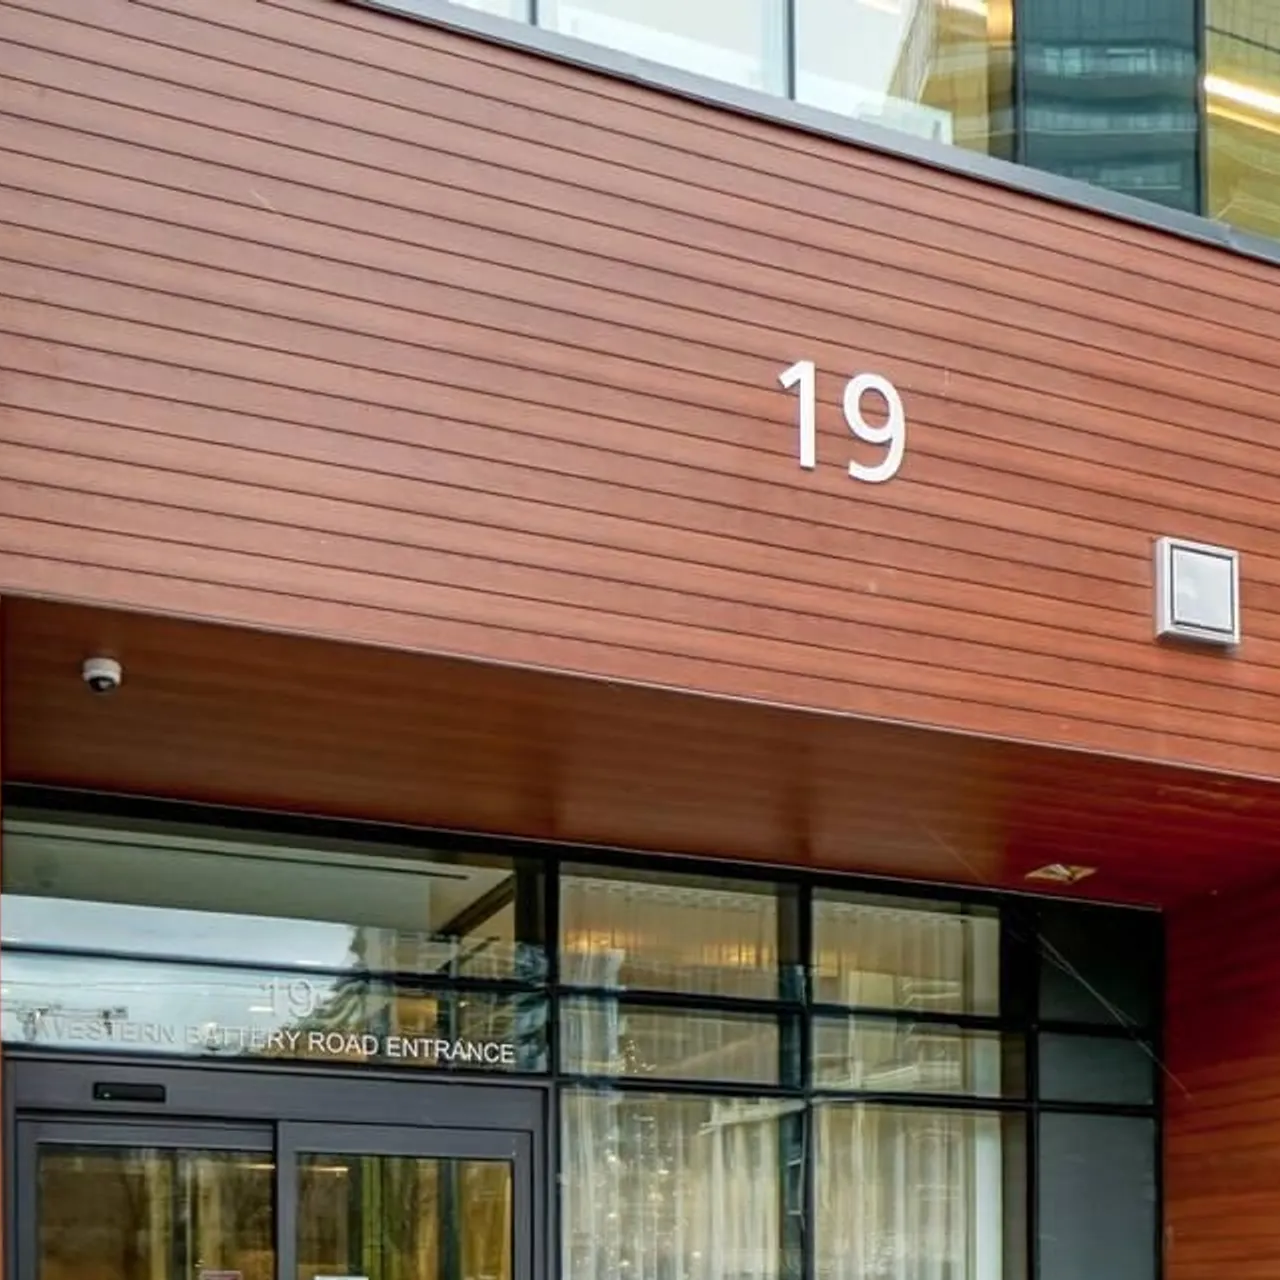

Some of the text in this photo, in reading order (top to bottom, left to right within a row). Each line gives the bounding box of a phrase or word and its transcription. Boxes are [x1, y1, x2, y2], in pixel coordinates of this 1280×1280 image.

[777, 359, 907, 483] 19
[261, 976, 316, 1018] 19
[28, 1016, 517, 1065] WESTERN BATTERY ROAD ENTRANCE
